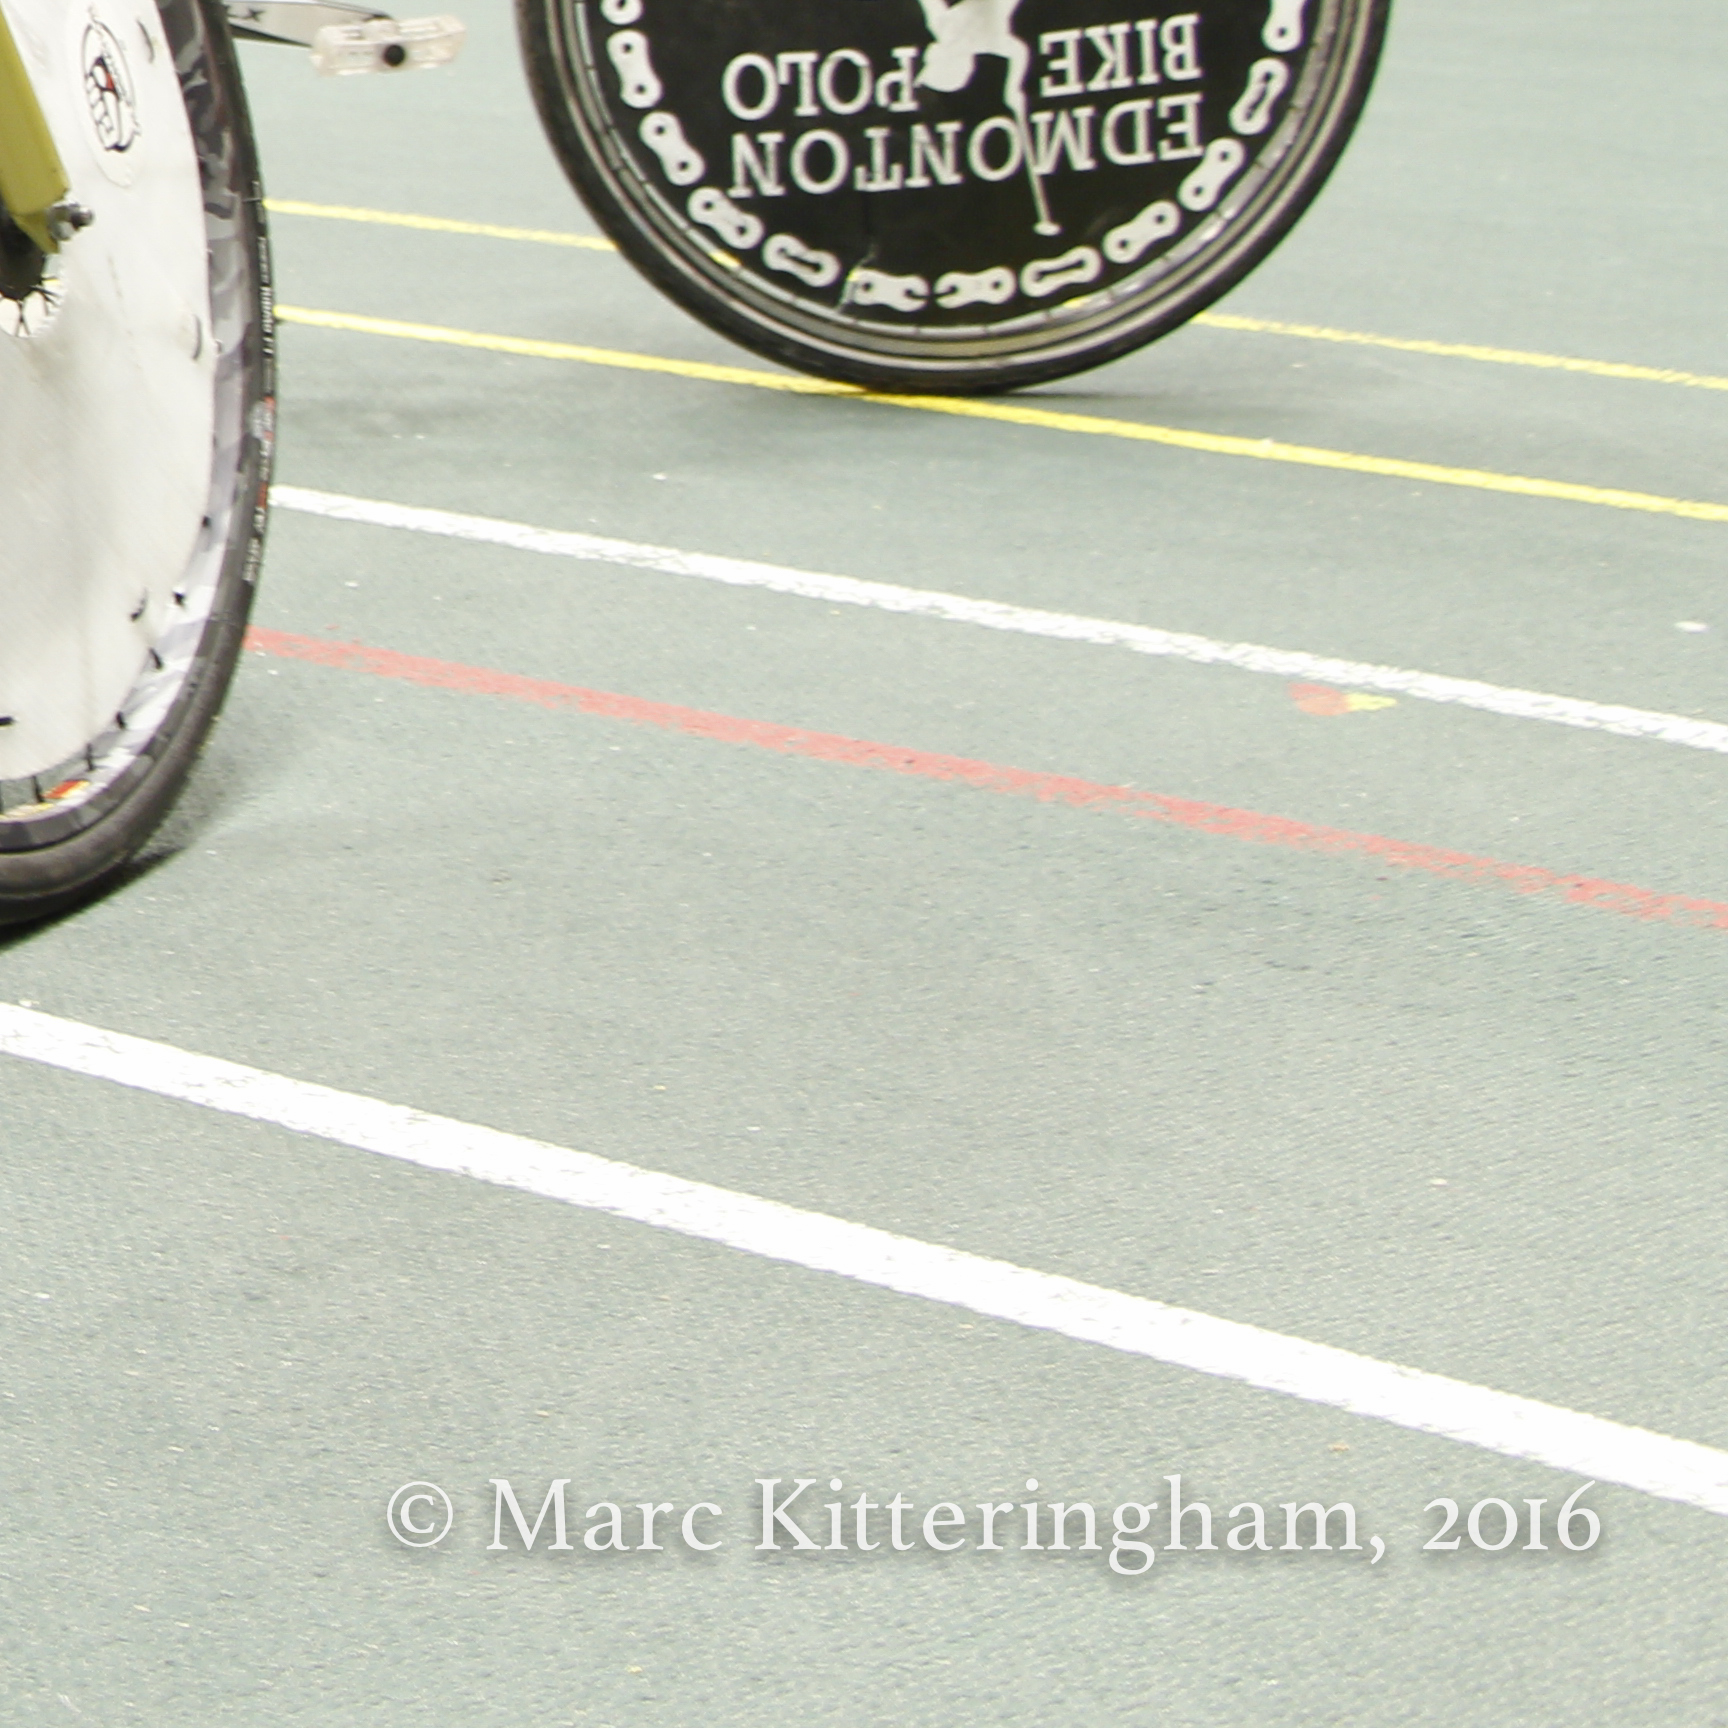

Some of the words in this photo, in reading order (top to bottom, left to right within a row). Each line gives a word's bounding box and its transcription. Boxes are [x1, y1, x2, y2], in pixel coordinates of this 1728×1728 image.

[722, 46, 921, 120] POLO
[1039, 13, 1203, 98] BIKE
[727, 92, 1204, 199] EDMONTON
